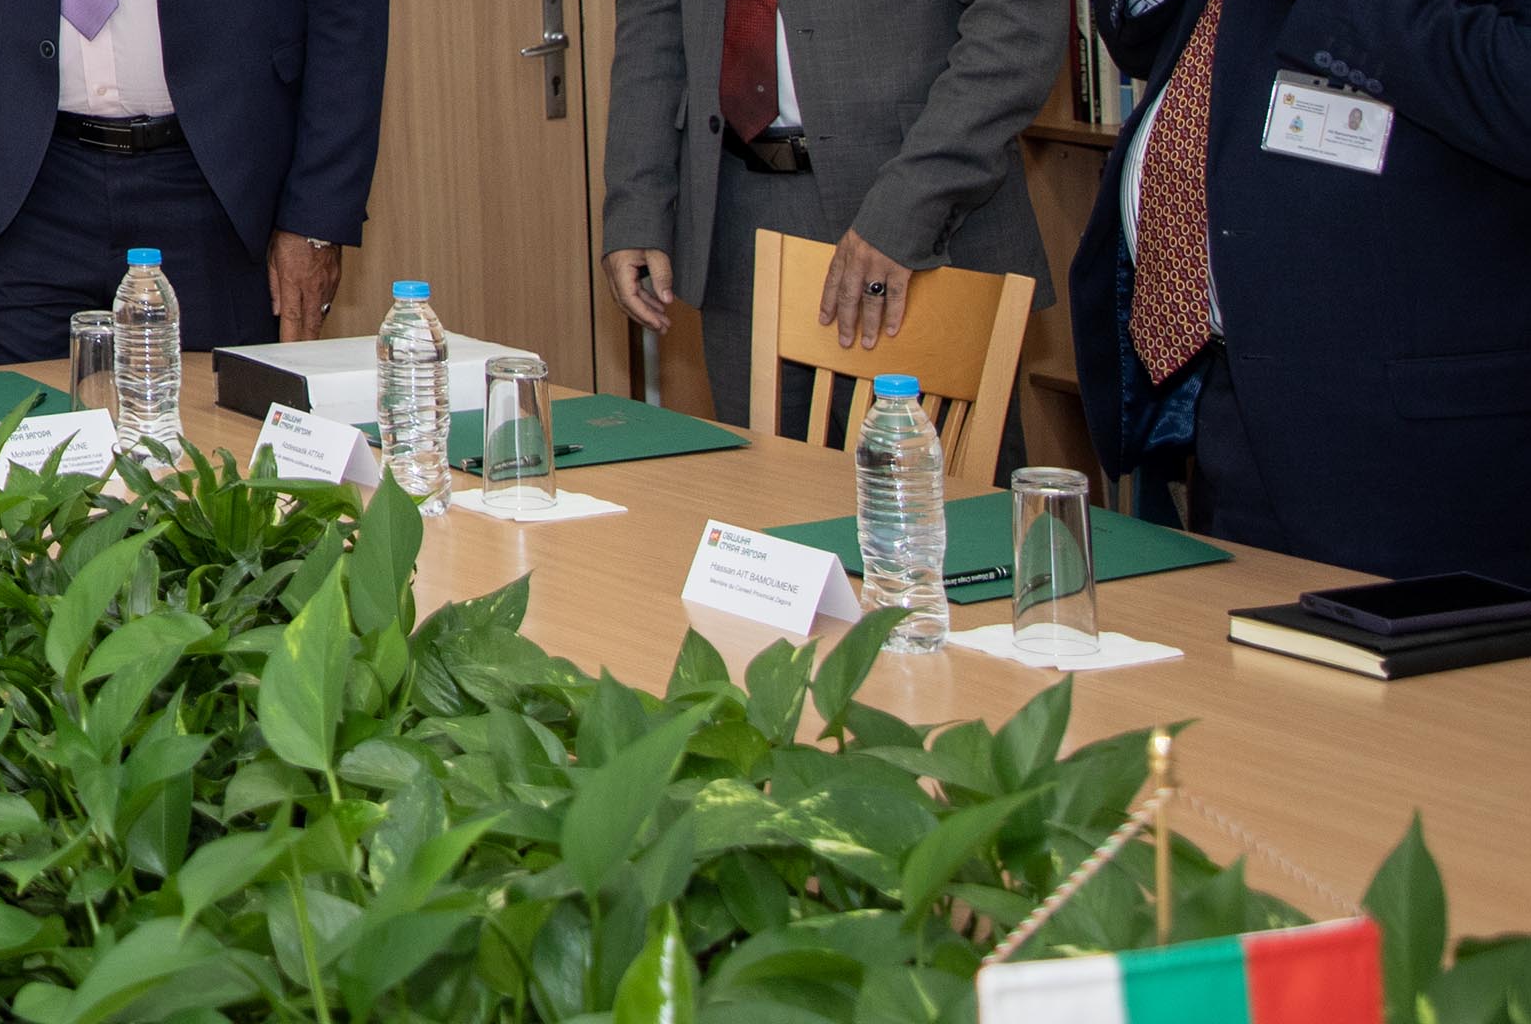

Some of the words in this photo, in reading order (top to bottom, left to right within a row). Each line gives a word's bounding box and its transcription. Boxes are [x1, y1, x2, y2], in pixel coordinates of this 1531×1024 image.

[25, 430, 52, 440] ЗАГОРА
[11, 448, 45, 458] Mohamed
[307, 448, 325, 460] ATTAR
[721, 531, 752, 545] ОБЩИНА
[719, 541, 741, 555] СТАРА
[740, 547, 768, 561] ЗАГОРА
[710, 561, 736, 577] Hassan
[736, 568, 750, 579] AIT
[749, 571, 799, 594] BAMOUMENE
